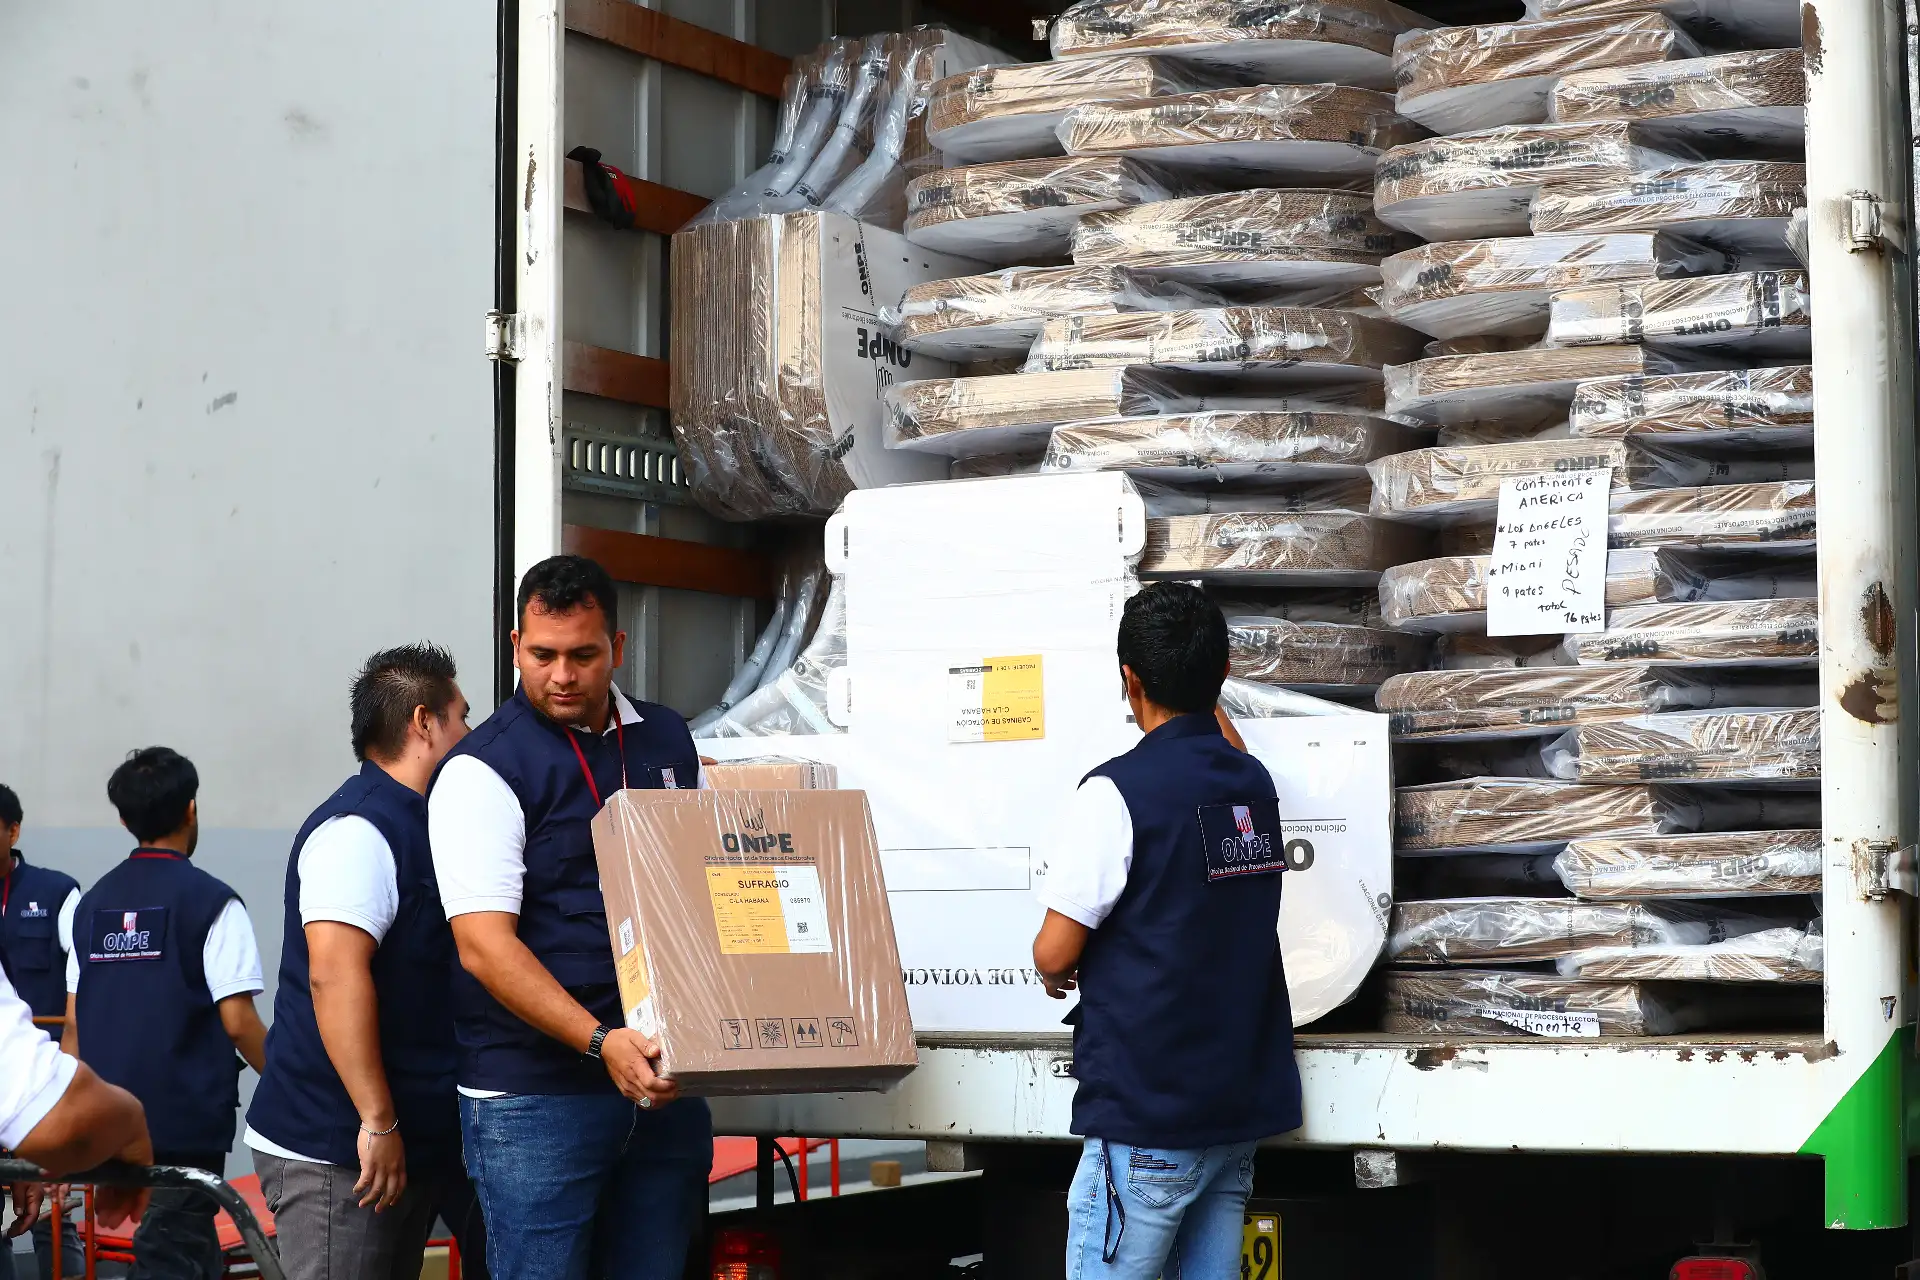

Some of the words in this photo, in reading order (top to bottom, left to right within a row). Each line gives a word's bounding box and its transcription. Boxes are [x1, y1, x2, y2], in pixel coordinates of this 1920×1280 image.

[1631, 178, 1689, 196] ONPE
[854, 242, 870, 296] ONPE
[1674, 319, 1733, 336] ONPE
[857, 328, 912, 369] ONPE
[1196, 343, 1251, 364] ONPE
[1554, 454, 1610, 472] ONPE
[1315, 823, 1347, 834] Oficina
[722, 833, 795, 854] ONPE
[1221, 833, 1272, 863] ONPE
[1711, 856, 1769, 878] ONPE
[737, 880, 790, 889] SUFRAGIO
[103, 930, 150, 951] ONPE
[901, 968, 984, 986] VOTACI
[987, 968, 1015, 985] DE
